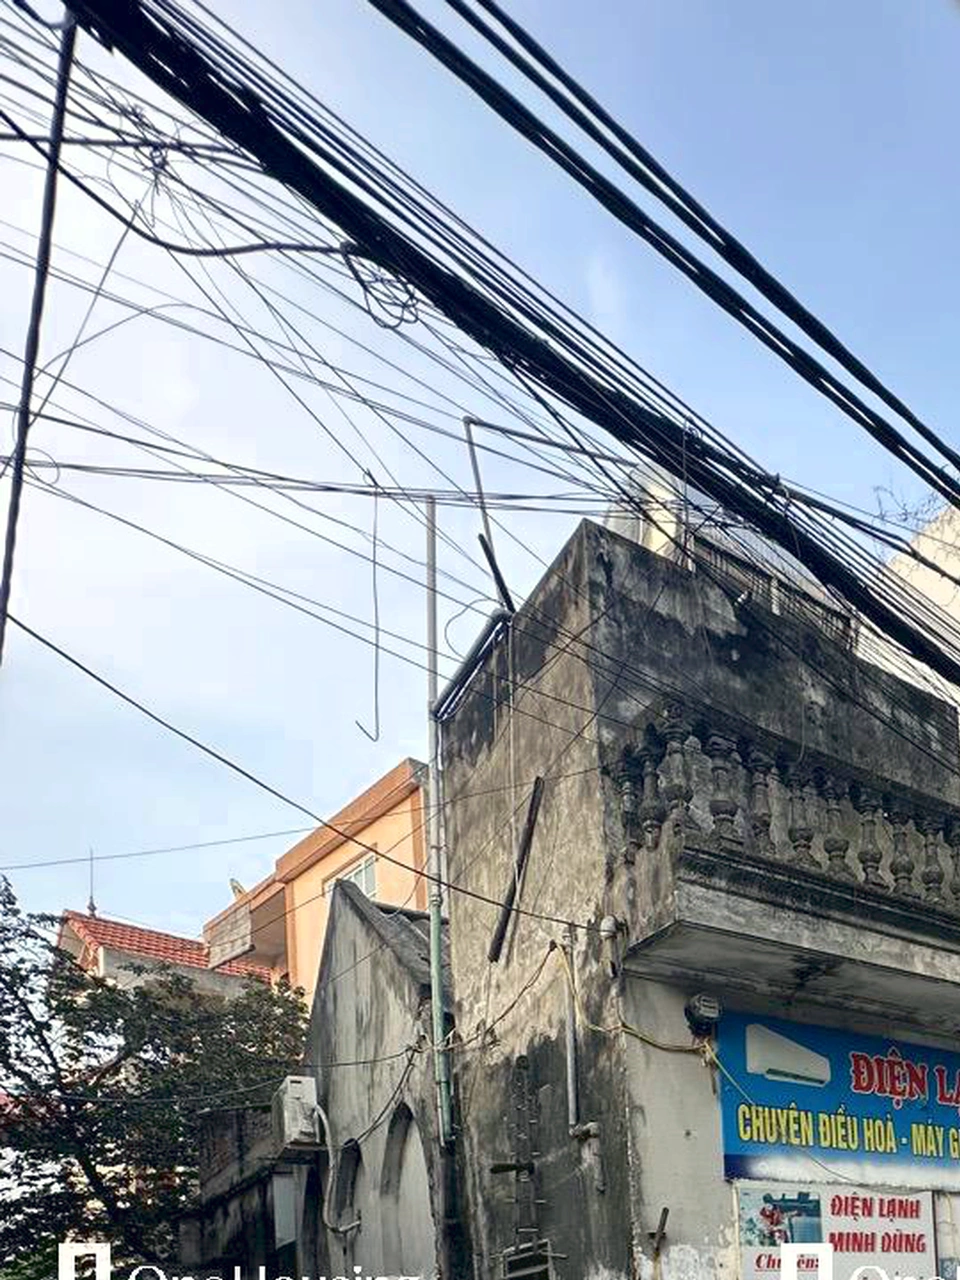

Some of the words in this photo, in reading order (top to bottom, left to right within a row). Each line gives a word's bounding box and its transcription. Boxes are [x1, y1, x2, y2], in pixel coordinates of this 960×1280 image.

[851, 1047, 928, 1109] ĐIỆN
[737, 1102, 814, 1147] CHUYÊN
[818, 1104, 859, 1151] ĐIỀU
[911, 1119, 945, 1158] MÁY
[830, 1192, 873, 1221] ĐIỆN
[879, 1198, 921, 1222] LẠNH
[829, 1233, 876, 1253] MINH
